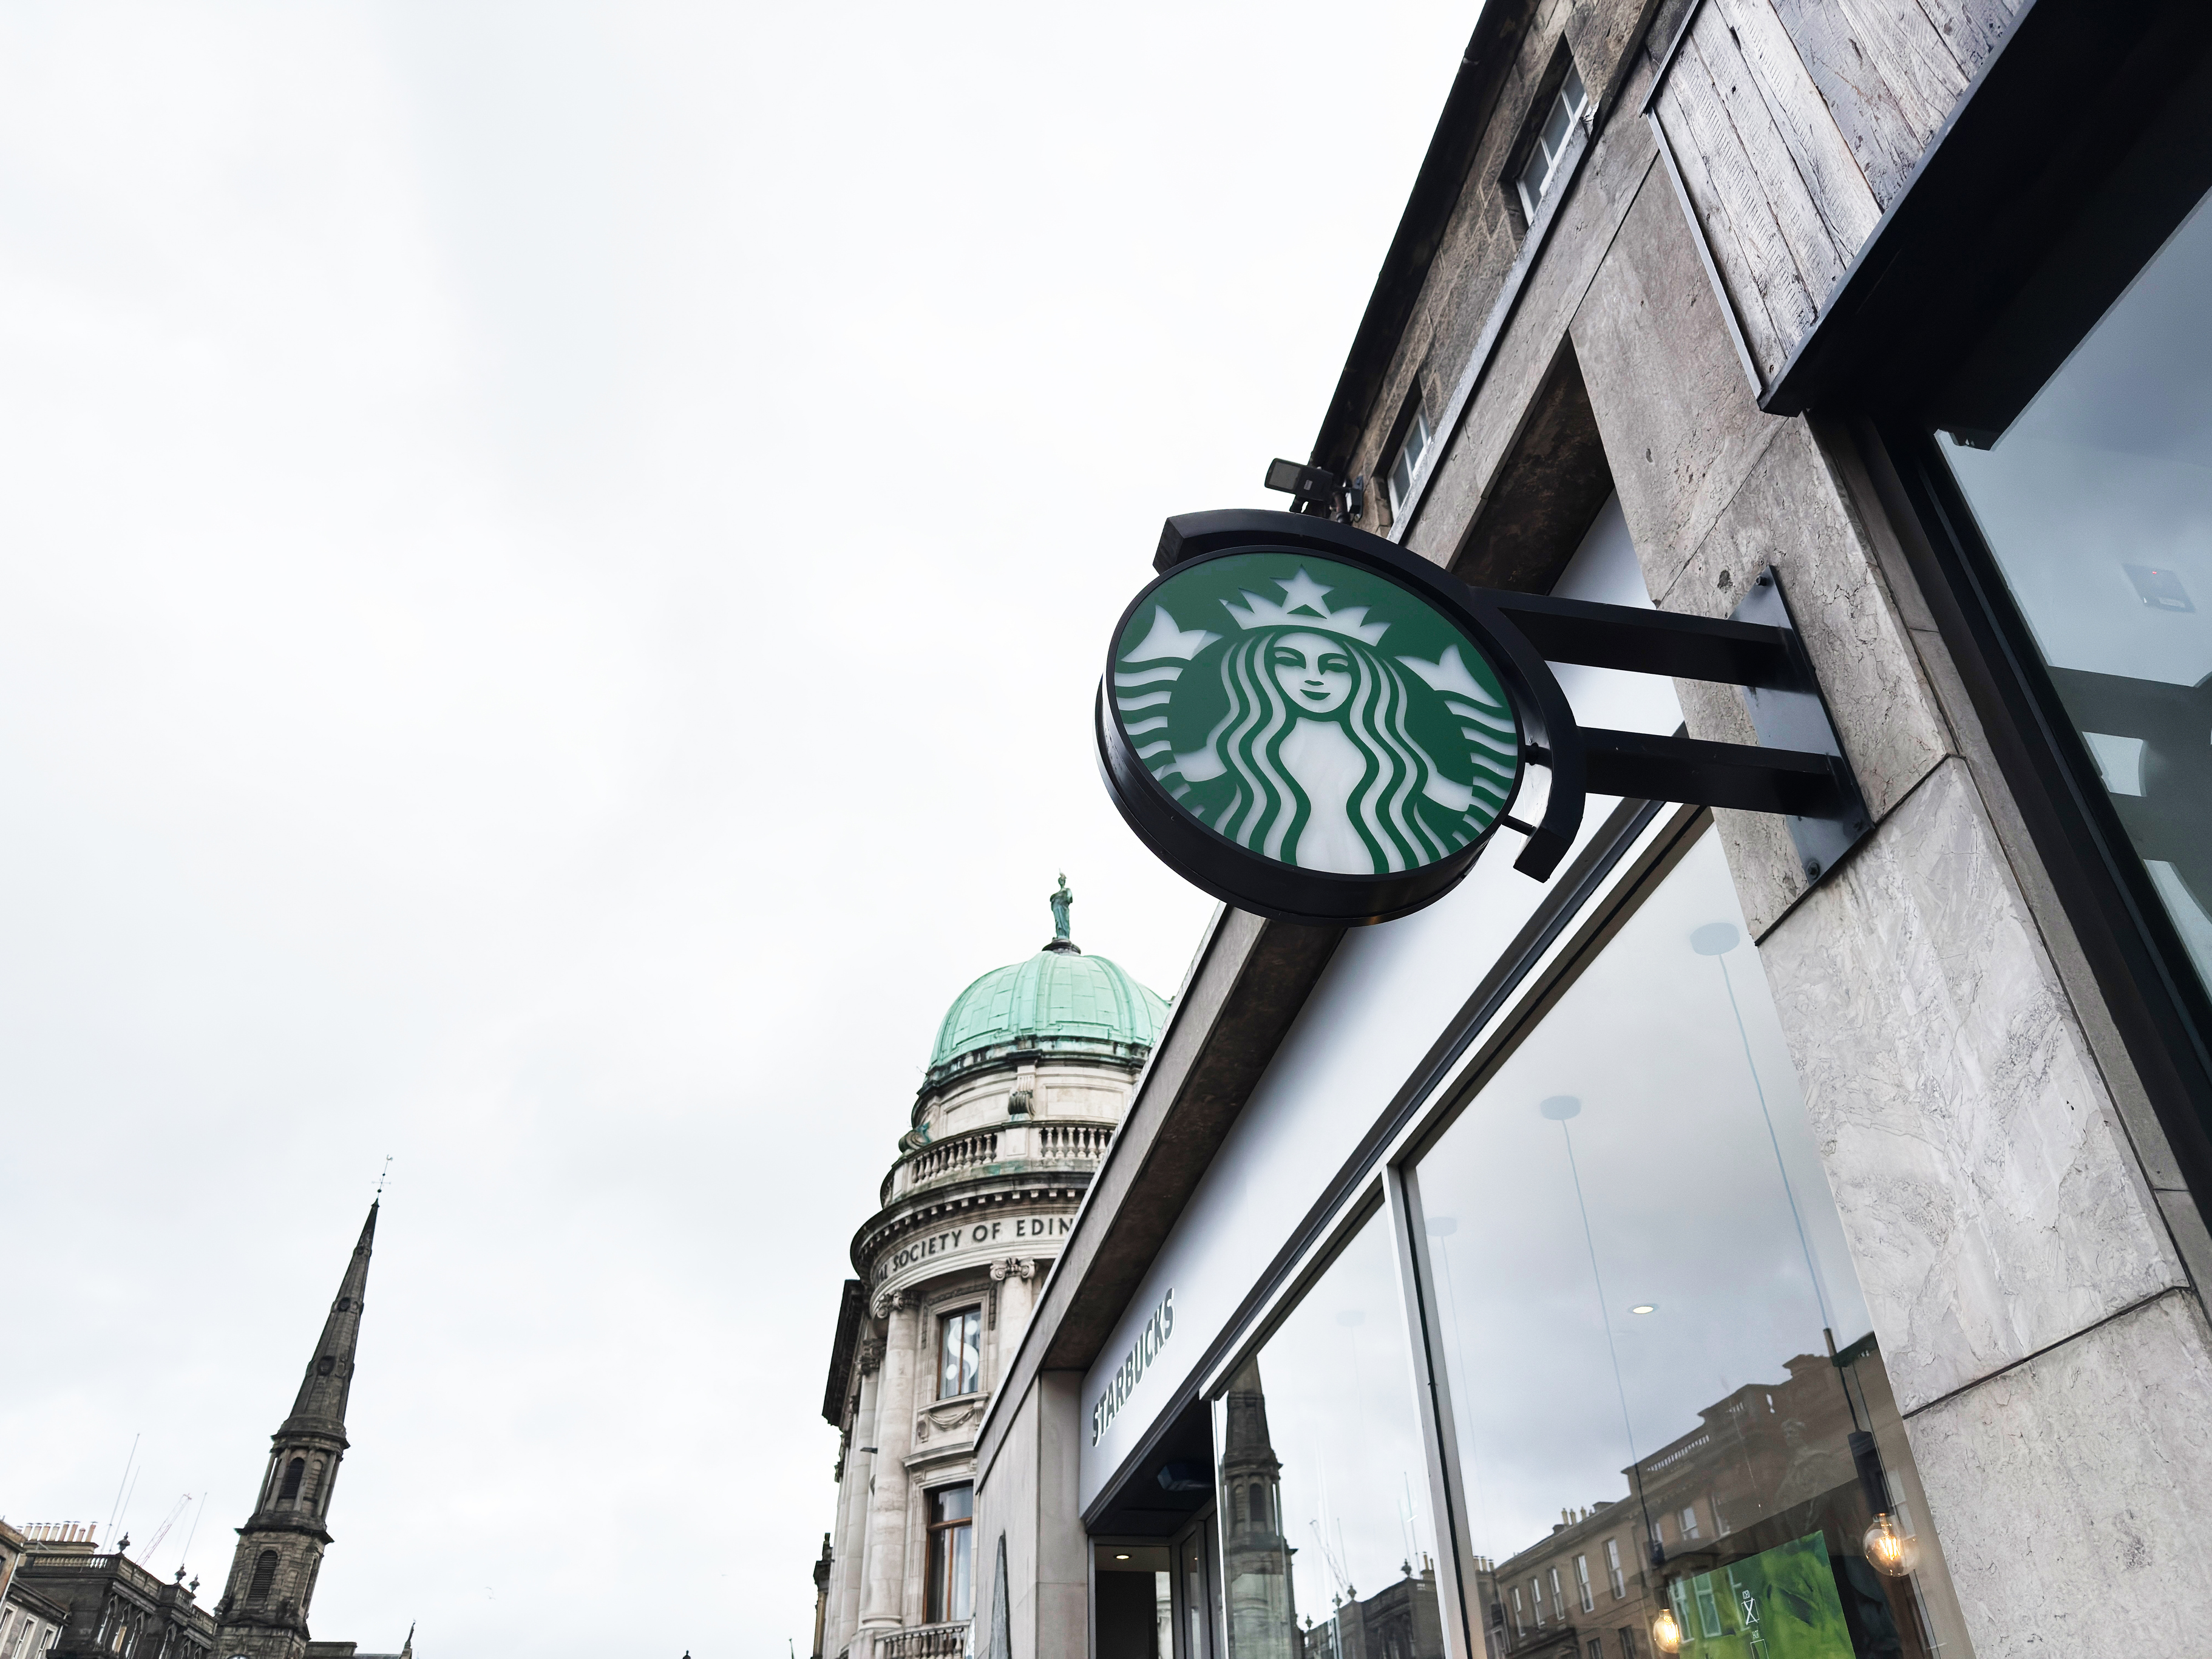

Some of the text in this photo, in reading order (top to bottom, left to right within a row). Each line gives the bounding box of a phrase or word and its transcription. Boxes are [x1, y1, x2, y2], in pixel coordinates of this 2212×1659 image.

[893, 1230, 962, 1272] SOCIETY
[972, 1222, 1001, 1243] OF
[1092, 1288, 1175, 1447] STARBUCKS
